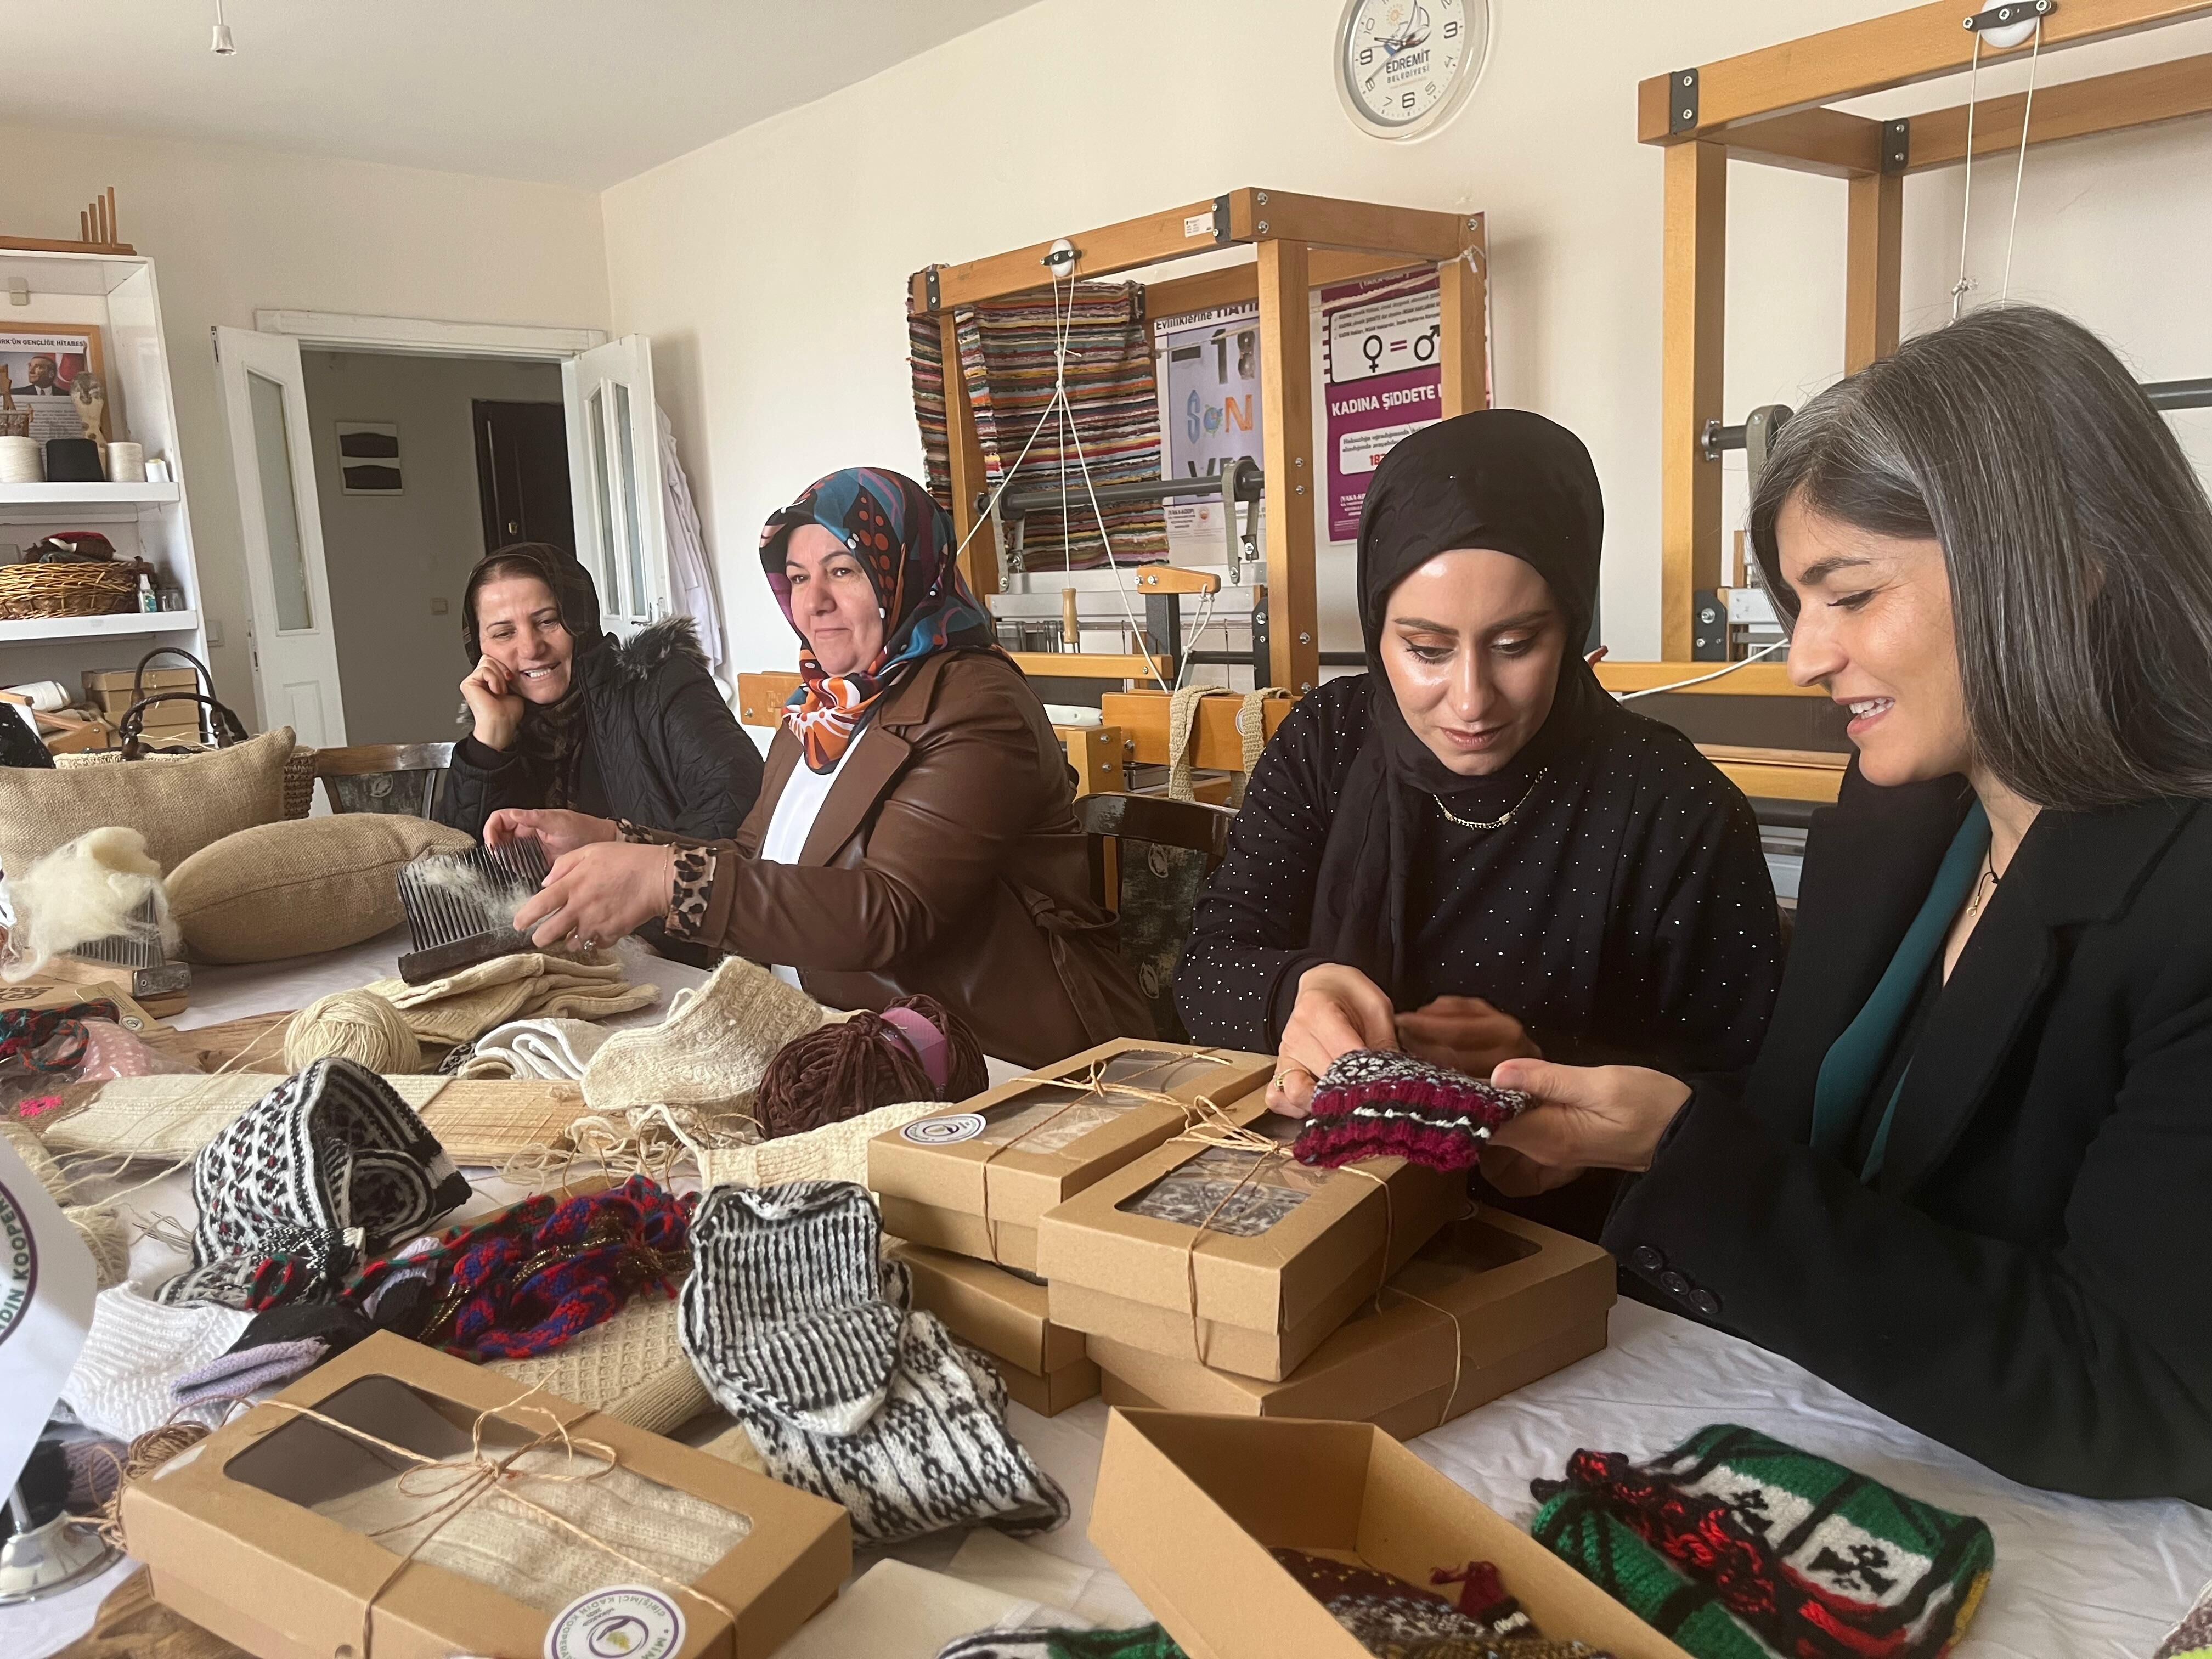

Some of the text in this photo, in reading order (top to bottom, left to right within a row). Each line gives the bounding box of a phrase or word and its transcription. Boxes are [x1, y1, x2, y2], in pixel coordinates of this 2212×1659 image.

[1443, 21, 1458, 39] 3
[1359, 48, 1373, 65] 9
[1386, 48, 1431, 74] EDREMİT
[1387, 65, 1430, 83] BELEDİYESİ
[1402, 92, 1415, 109] 6
[23, 338, 55, 347] GENÇLİĞE
[1331, 395, 1380, 416] KADINA
